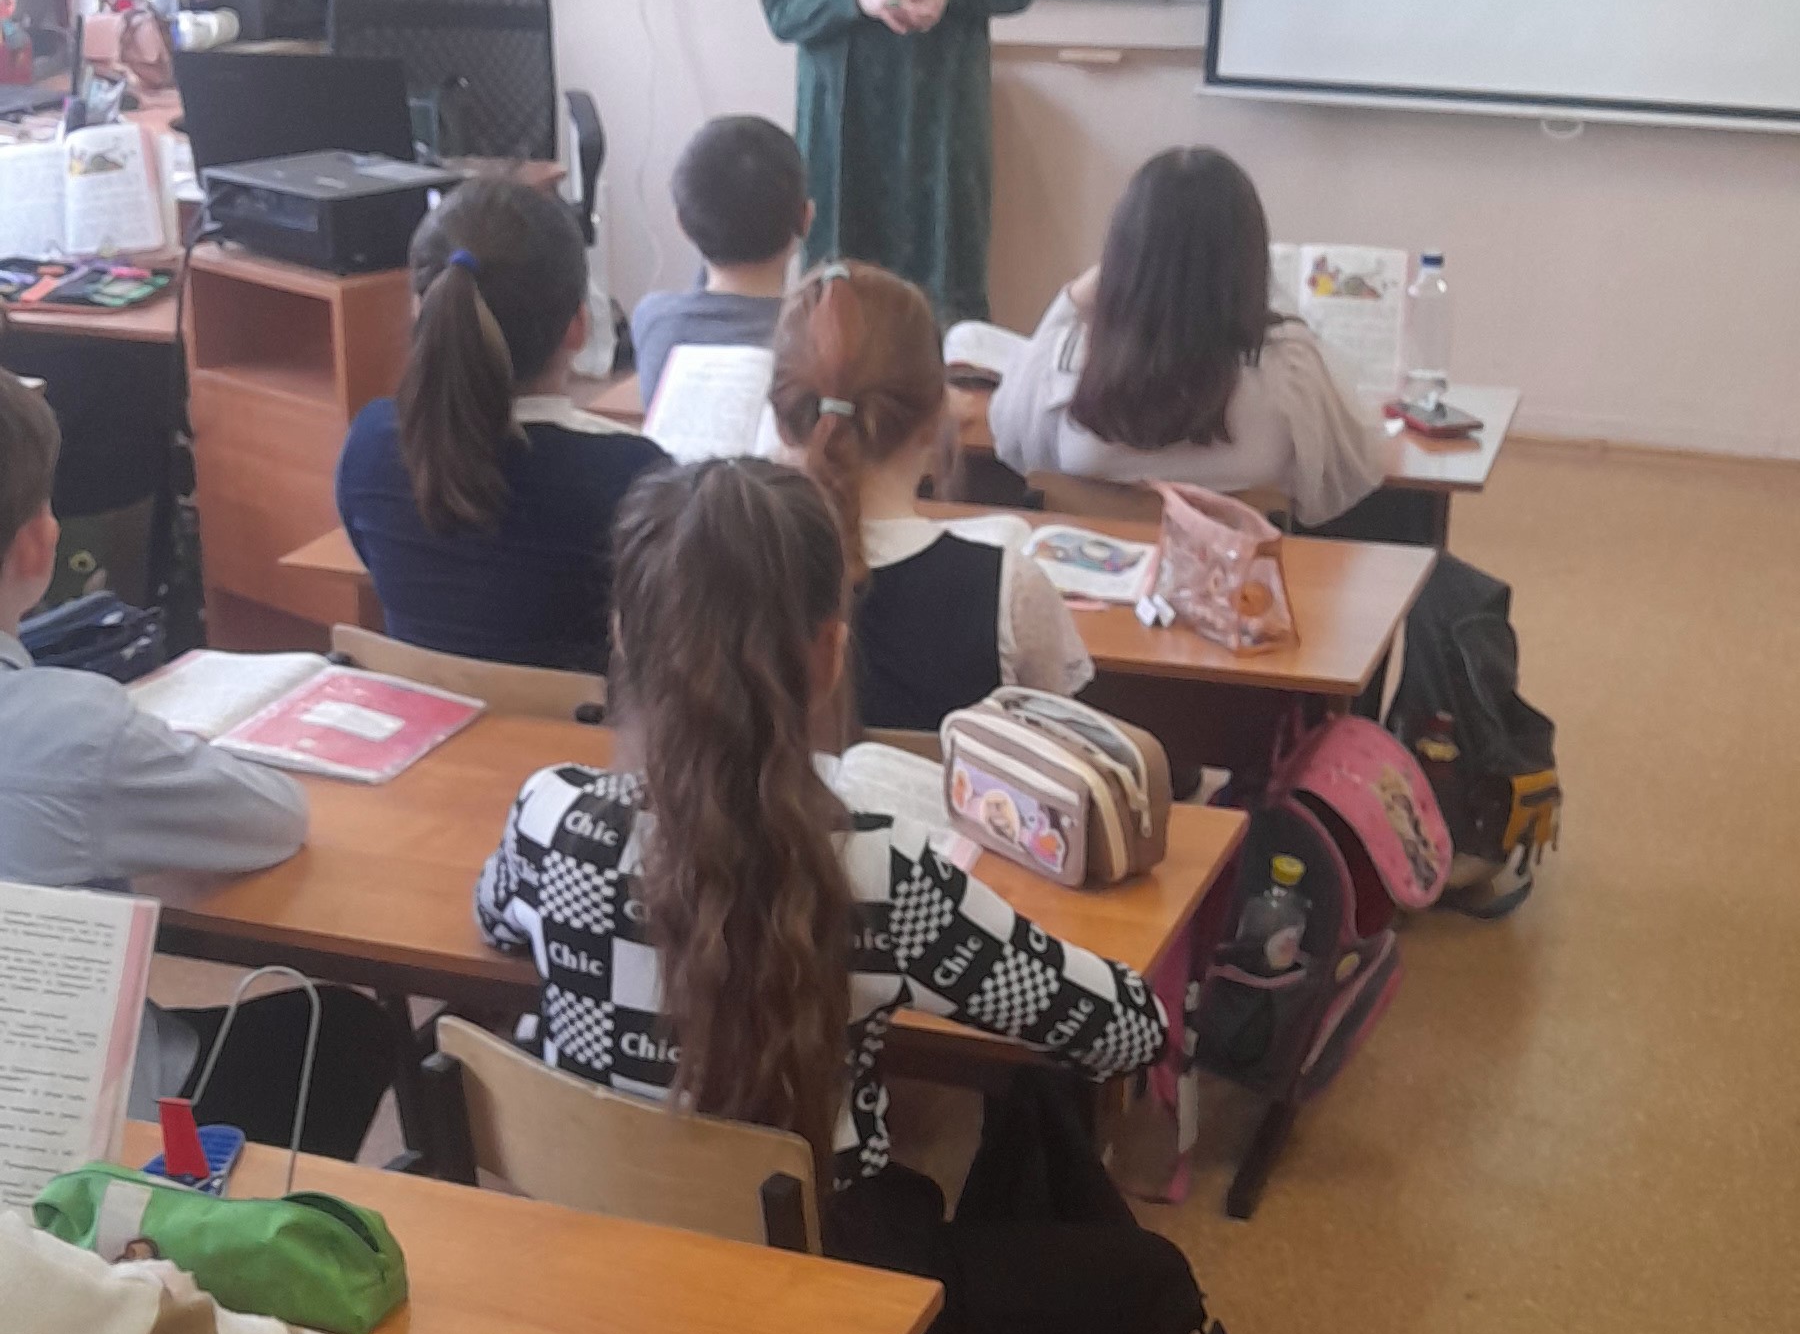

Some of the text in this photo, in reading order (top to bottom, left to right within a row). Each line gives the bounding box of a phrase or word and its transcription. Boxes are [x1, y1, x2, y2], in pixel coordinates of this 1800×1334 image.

[563, 809, 620, 847] Chic
[548, 940, 605, 977] Chic
[932, 935, 984, 987] Chic
[1045, 996, 1096, 1045] Chic
[619, 1031, 682, 1065] Chic
